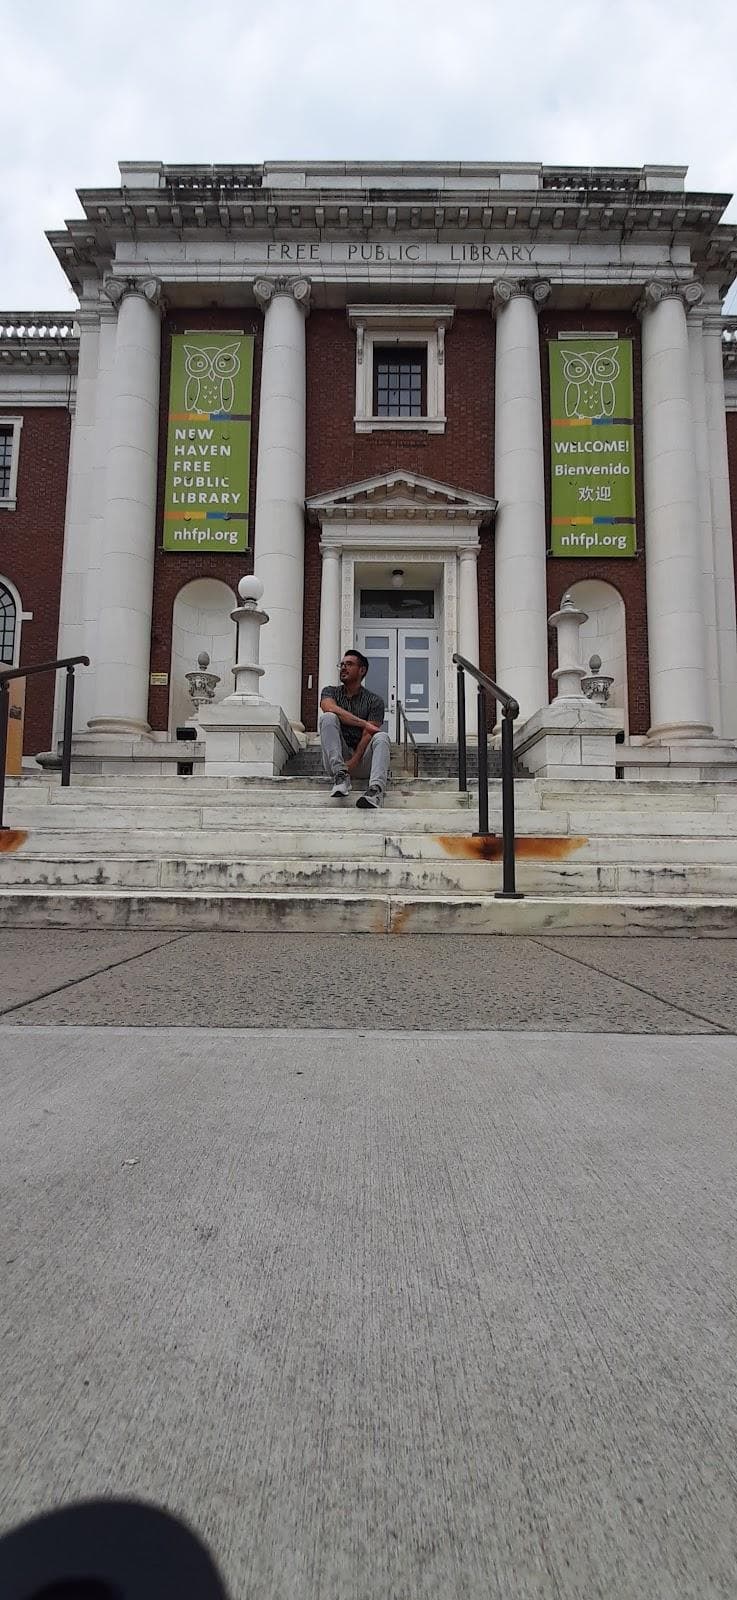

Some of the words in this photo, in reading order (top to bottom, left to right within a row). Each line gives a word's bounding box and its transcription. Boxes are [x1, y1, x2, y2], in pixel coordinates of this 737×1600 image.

[267, 244, 320, 260] FREE
[348, 244, 420, 261] PUBLIC
[450, 245, 536, 261] LIBRARY
[175, 428, 214, 440] NEW
[174, 445, 231, 457] HAVEN
[554, 440, 629, 453] WELCOME!
[173, 461, 211, 472] FREE
[555, 463, 630, 476] Bienvenido
[173, 476, 229, 488] PUBLIC
[172, 493, 241, 504] LIBRARY
[578, 486, 611, 502] 欢迎
[174, 527, 238, 544] nhfpl.org
[561, 533, 627, 549] nhfpl.org
